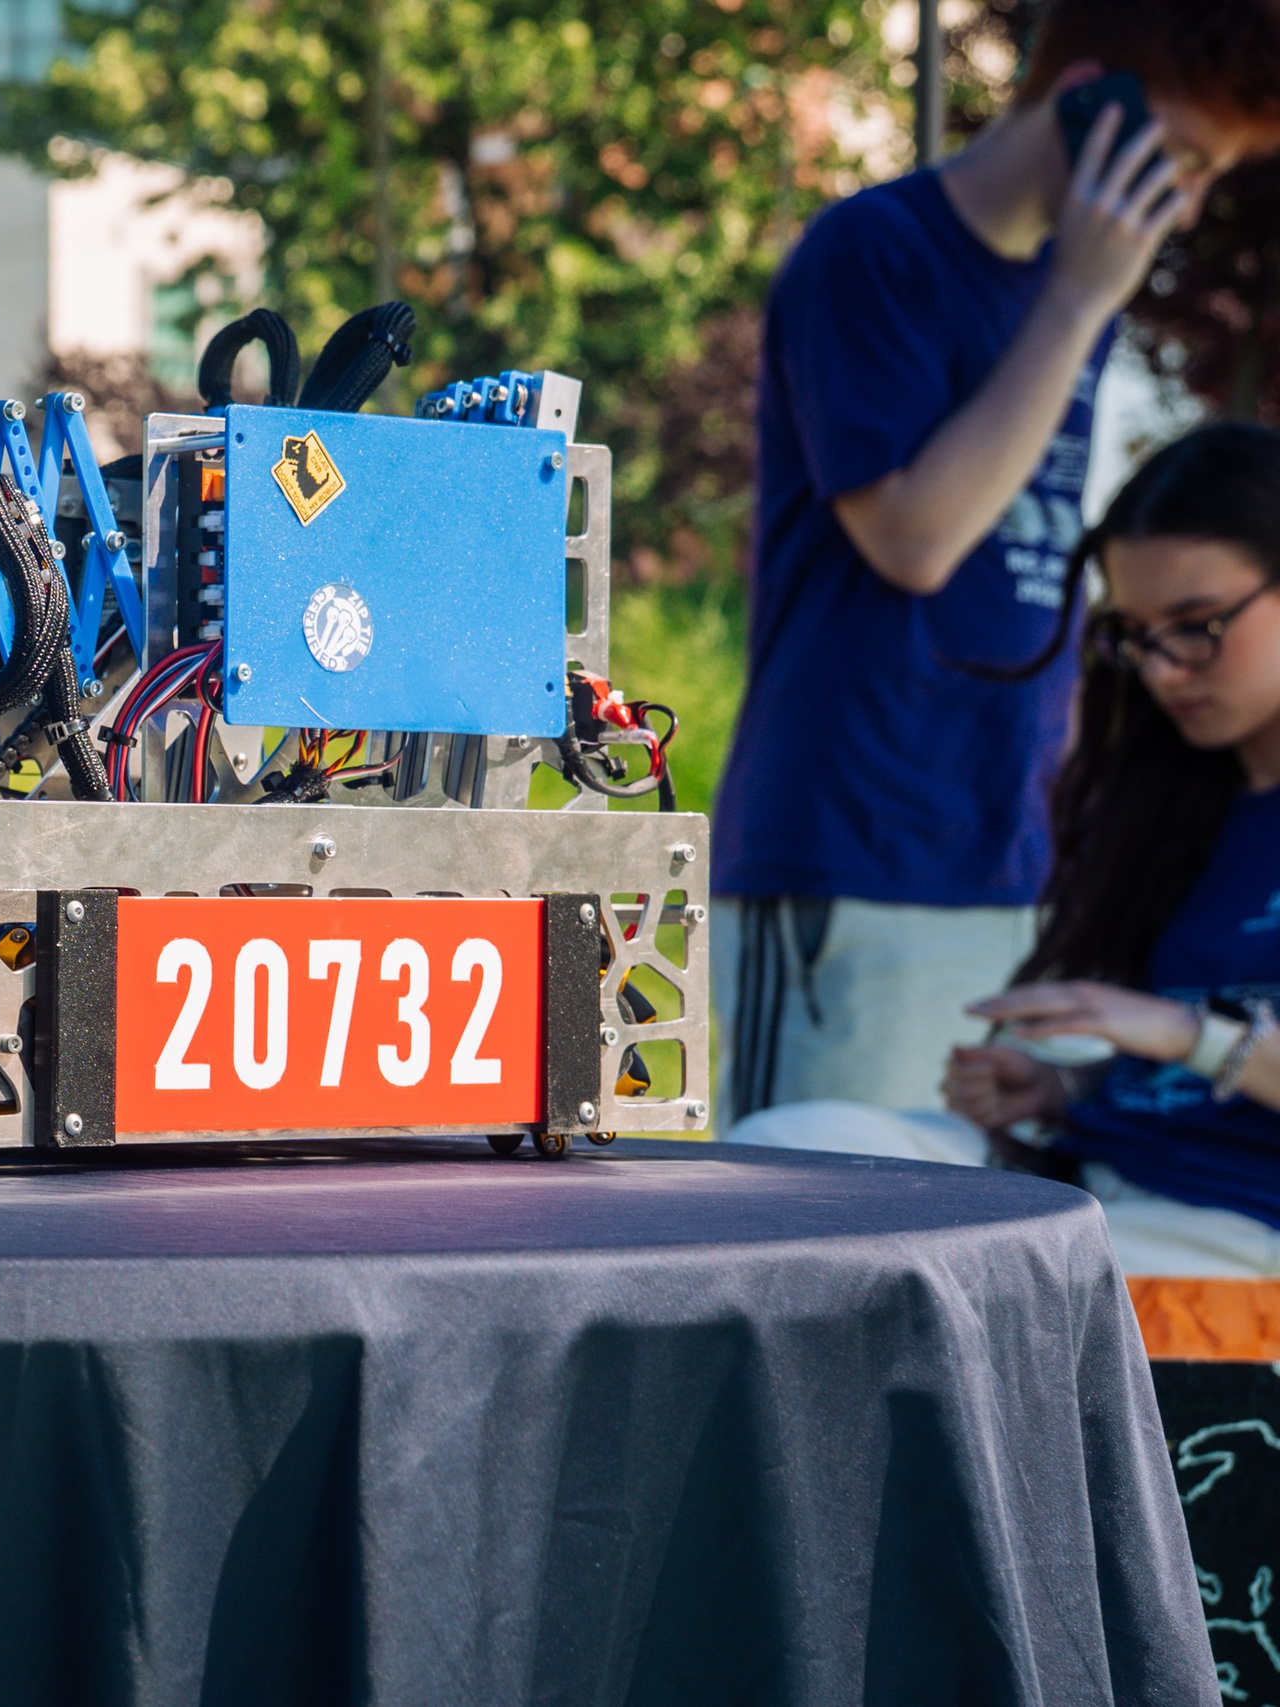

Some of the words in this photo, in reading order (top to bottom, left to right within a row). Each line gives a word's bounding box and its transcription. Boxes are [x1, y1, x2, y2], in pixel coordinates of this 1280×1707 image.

[314, 448, 330, 472] ATLAS
[291, 492, 309, 518] TOUCH
[308, 500, 319, 511] MY
[317, 481, 338, 502] ROBOT
[347, 590, 369, 618] ZIP
[305, 591, 338, 670] CERTIFIED
[356, 625, 371, 655] TIE
[154, 937, 503, 1090] 20732
